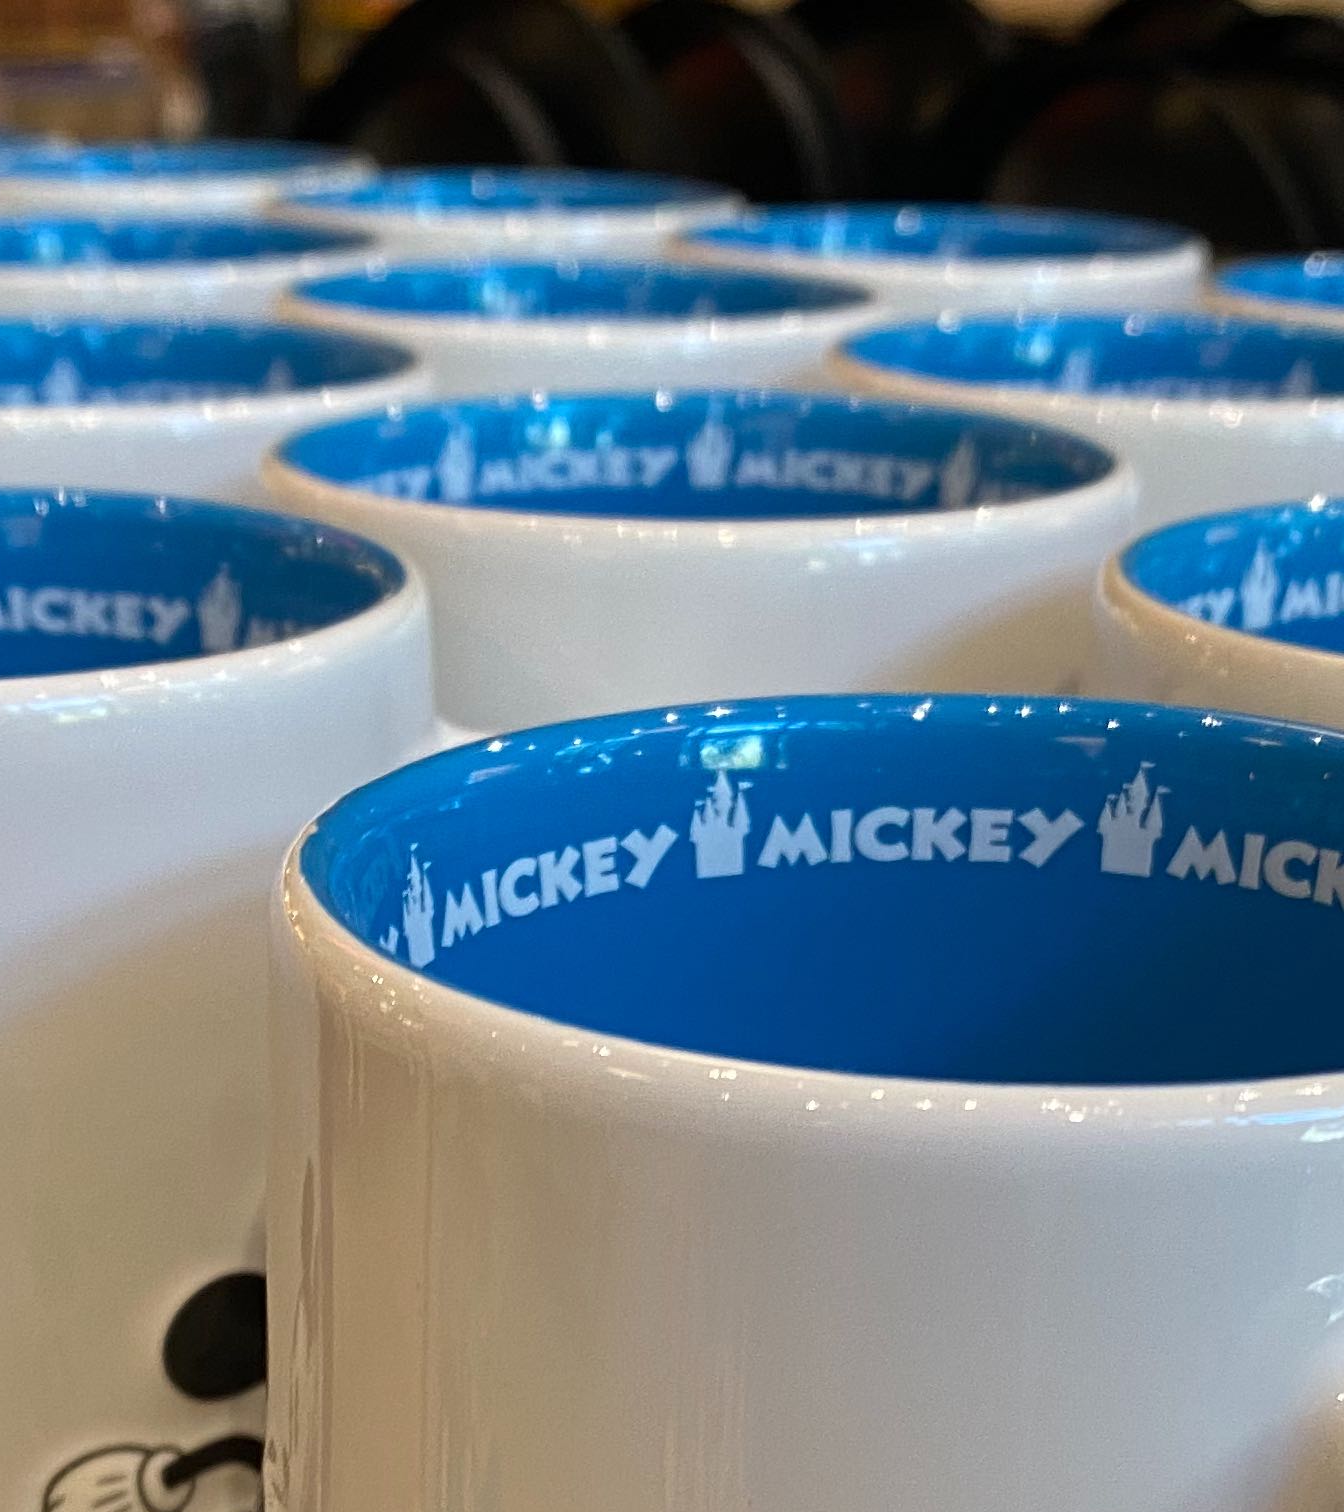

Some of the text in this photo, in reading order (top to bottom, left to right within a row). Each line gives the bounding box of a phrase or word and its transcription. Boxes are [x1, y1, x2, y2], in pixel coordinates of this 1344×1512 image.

[478, 446, 678, 496] MICKEY
[734, 448, 936, 501] MICKEY
[441, 823, 679, 948] MICKEY
[756, 805, 1086, 869] MICKEY
